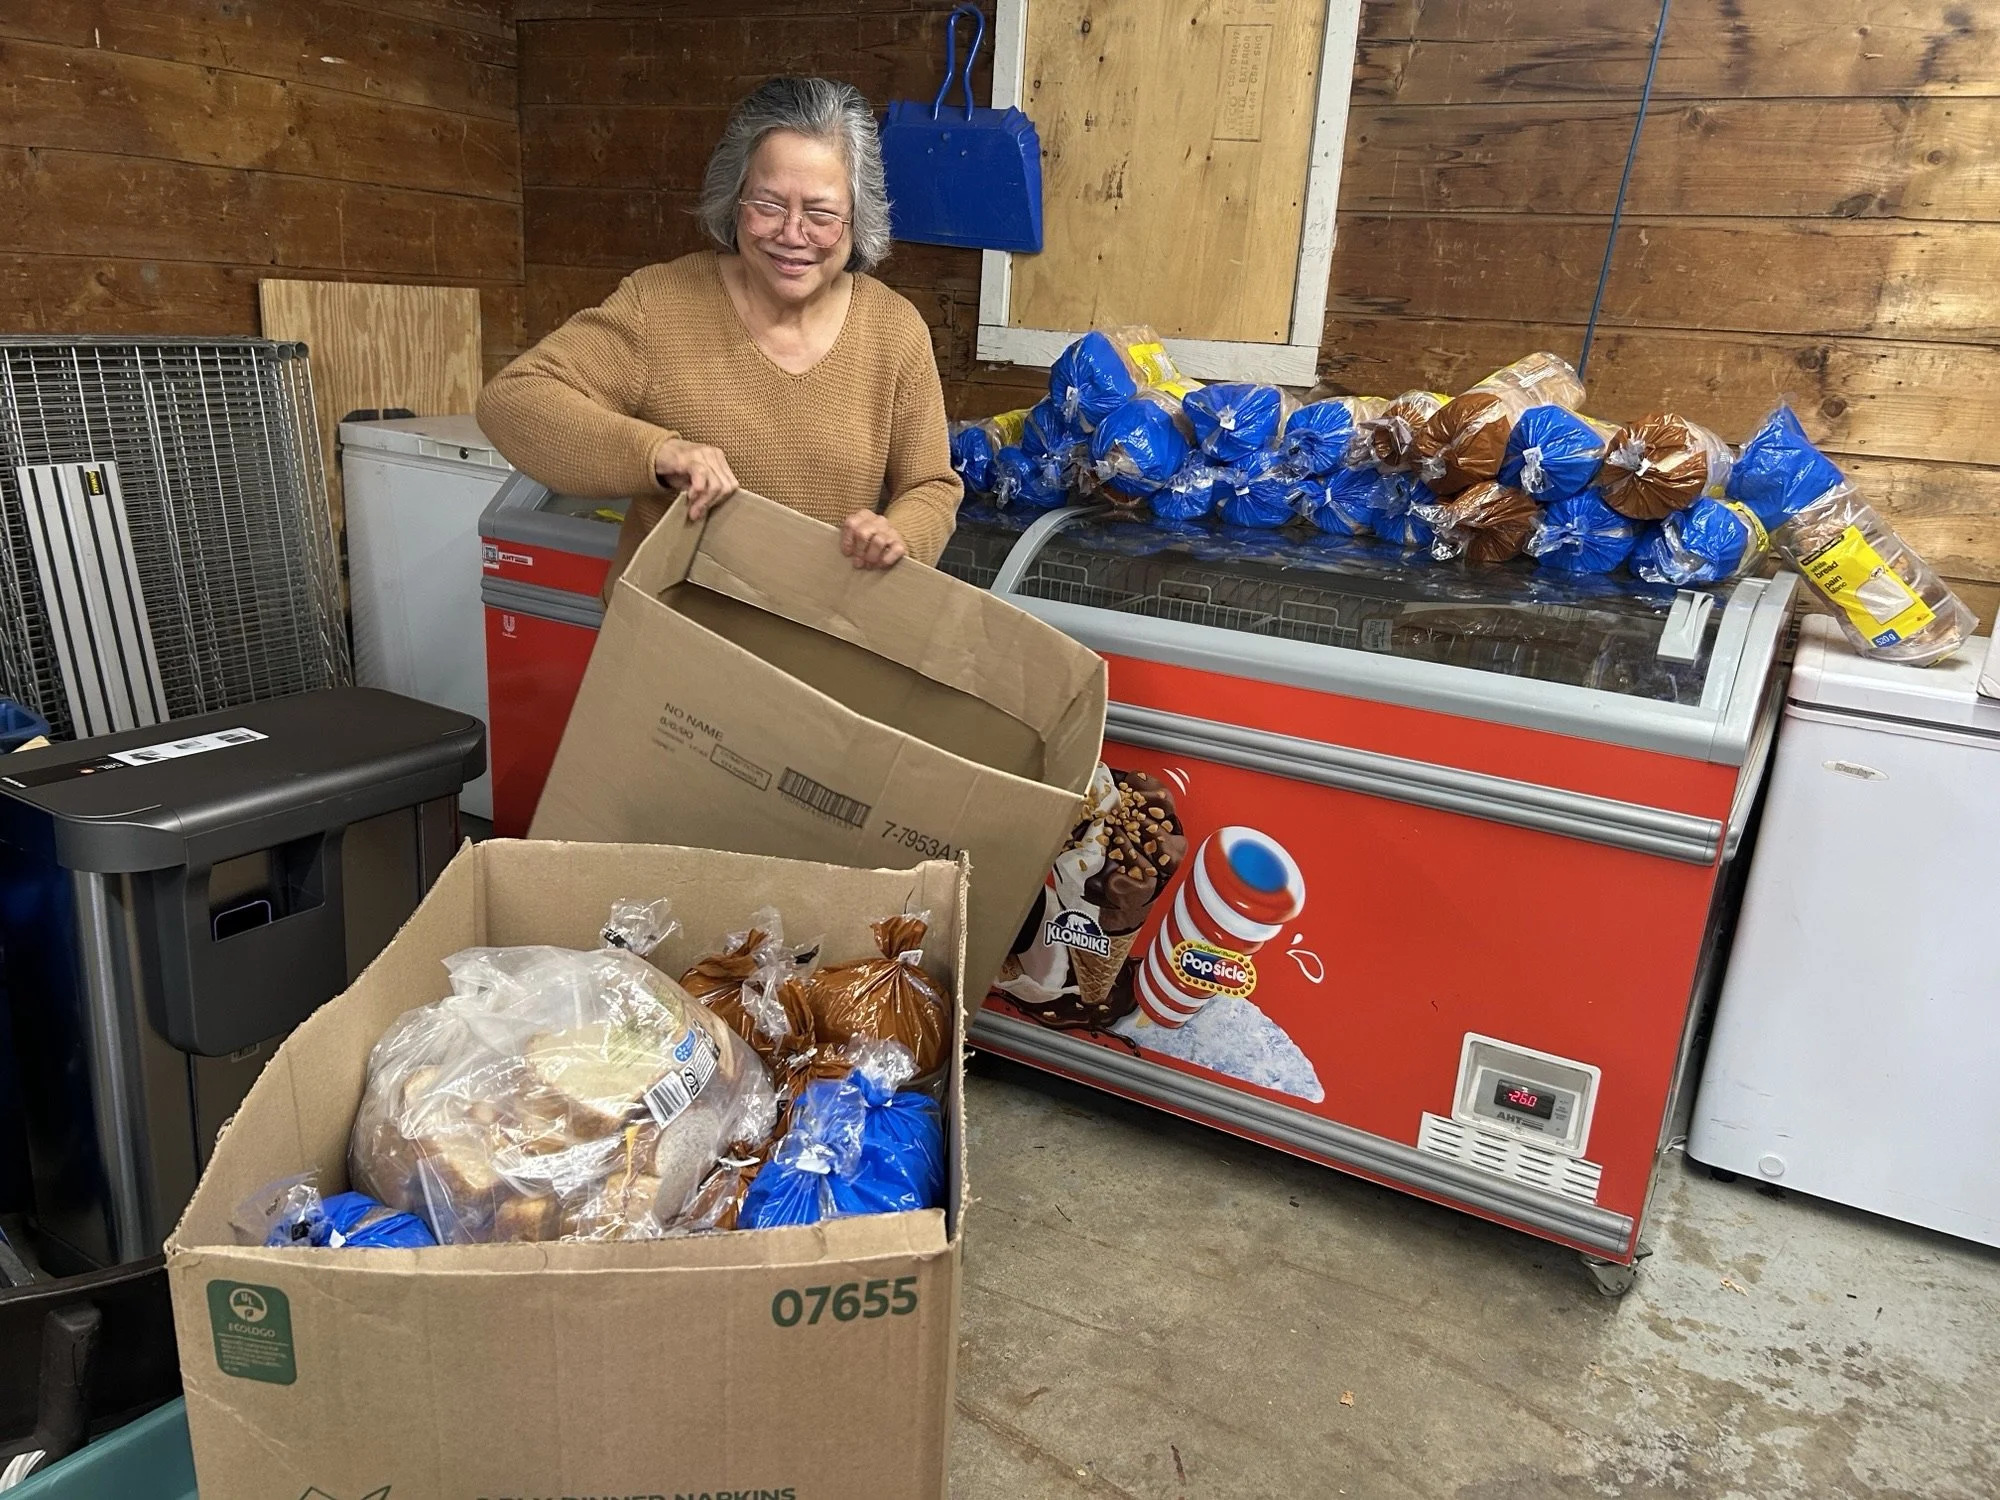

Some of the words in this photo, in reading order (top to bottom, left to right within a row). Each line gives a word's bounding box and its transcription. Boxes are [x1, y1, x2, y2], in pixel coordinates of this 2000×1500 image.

[1239, 35, 1251, 83] EXTERIOR
[1814, 561, 1838, 579] bread
[1824, 574, 1842, 589] pain
[1830, 581, 1847, 595] blanc
[1876, 635, 1890, 647] 520
[1889, 633, 1896, 642] g
[664, 702, 684, 719] NO
[686, 714, 724, 742] NAME
[1046, 924, 1108, 954] KLONDIKE
[1182, 952, 1247, 983] Popsicle
[1496, 1111, 1523, 1124] AHT
[771, 1276, 918, 1327] 07655
[228, 1322, 276, 1338] ECOLOGO
